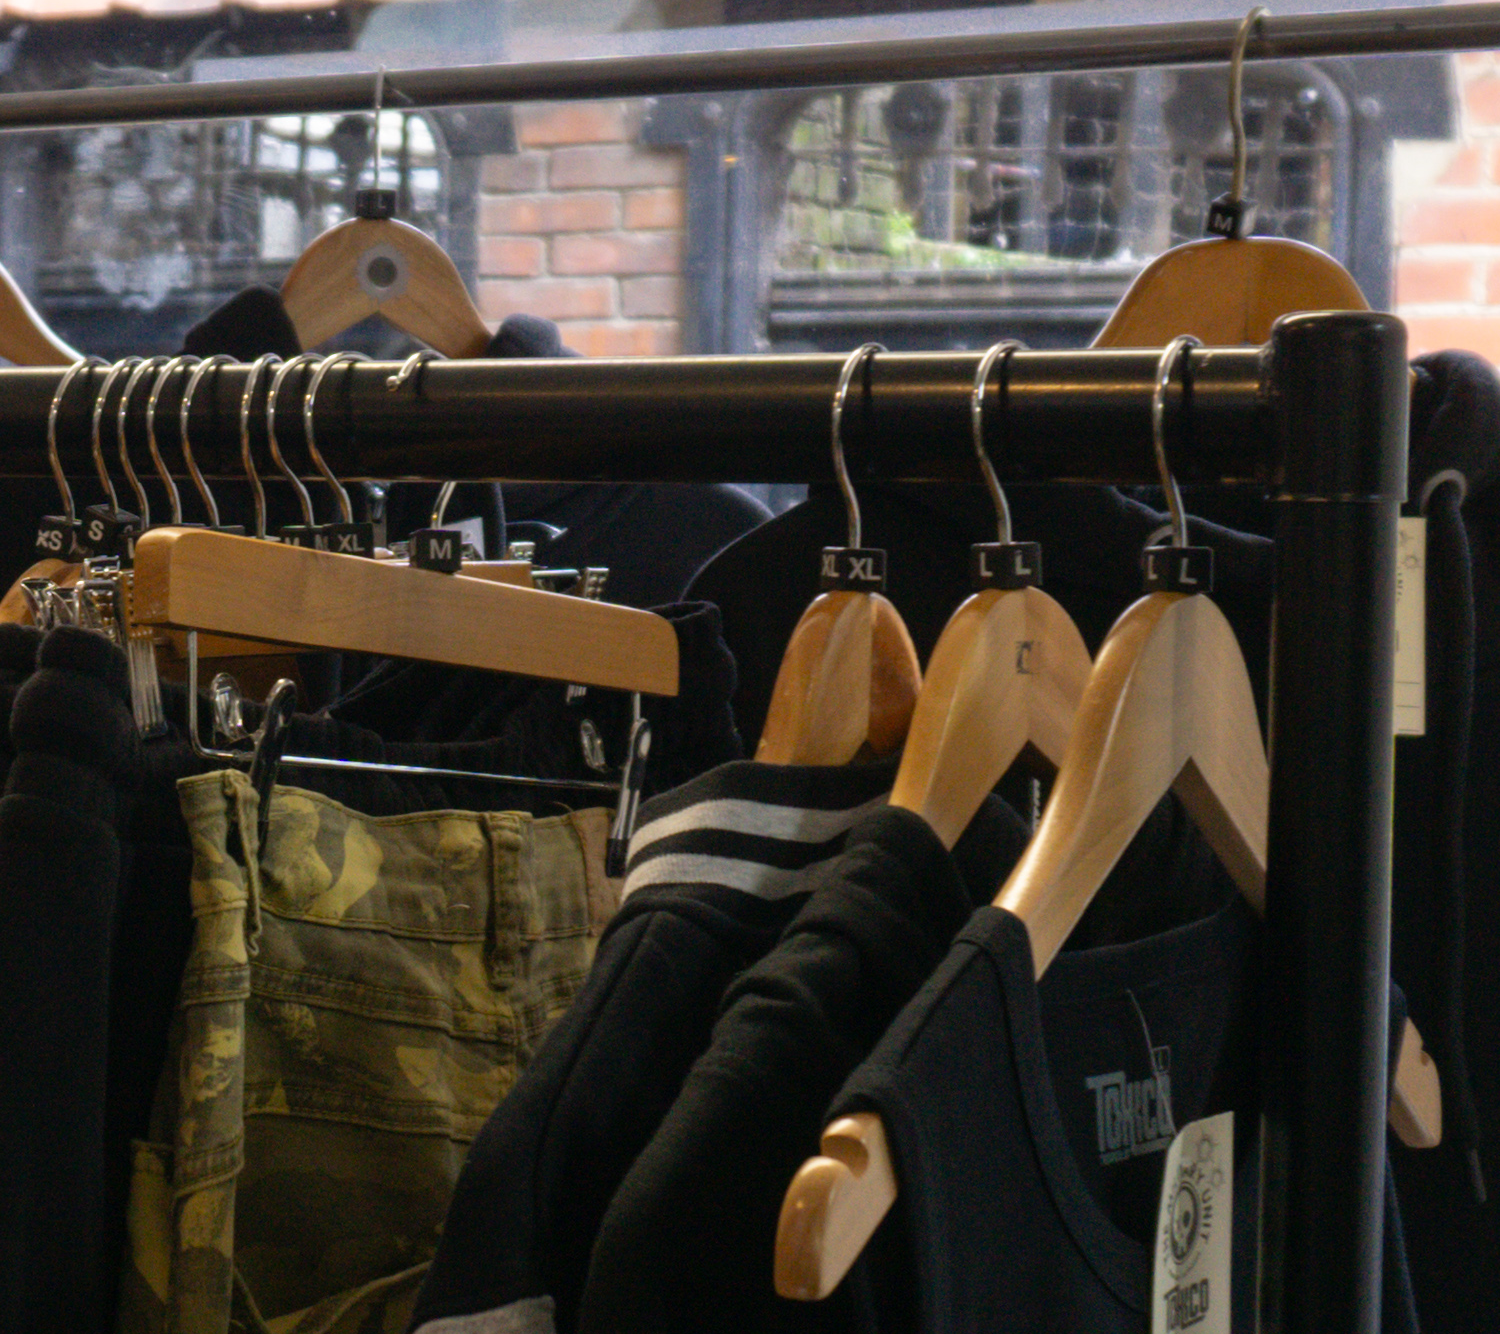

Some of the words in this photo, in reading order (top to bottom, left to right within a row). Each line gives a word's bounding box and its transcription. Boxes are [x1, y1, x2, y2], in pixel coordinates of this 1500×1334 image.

[35, 529, 63, 551] XS
[88, 519, 103, 542] S
[337, 533, 365, 553] XL
[429, 538, 453, 560] M
[821, 554, 839, 578] XL
[848, 556, 882, 581] XL
[979, 553, 994, 578] L
[1014, 550, 1032, 575] L
[1179, 557, 1198, 585] L
